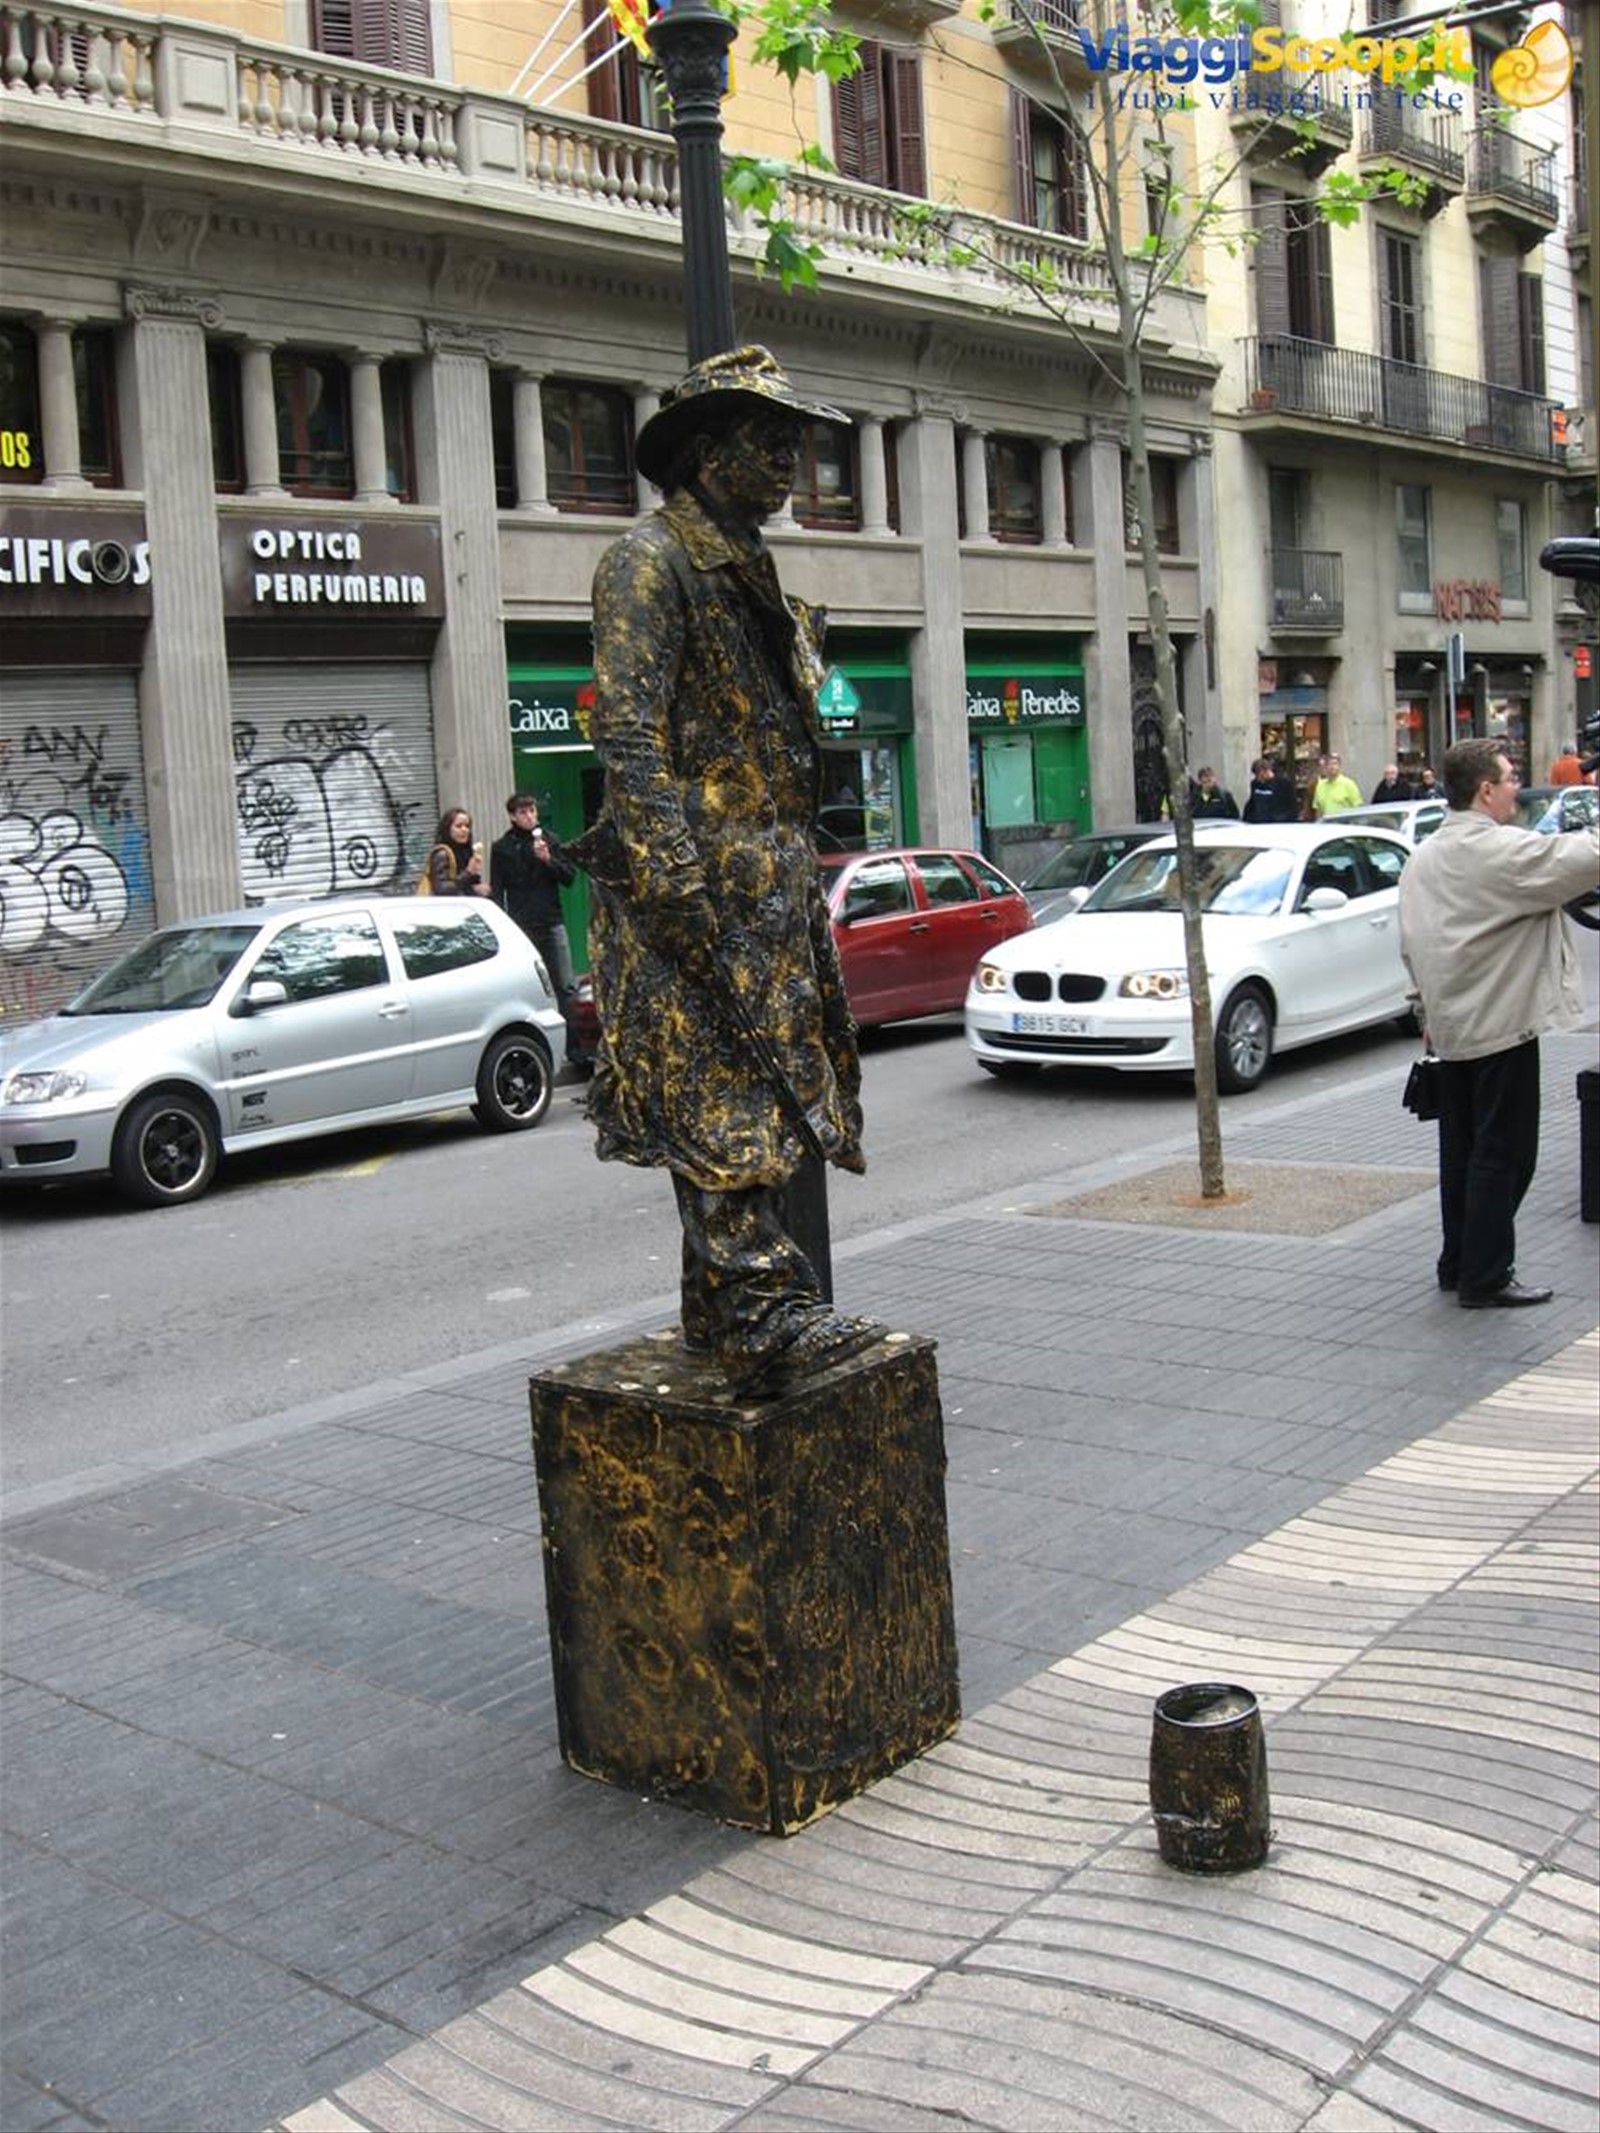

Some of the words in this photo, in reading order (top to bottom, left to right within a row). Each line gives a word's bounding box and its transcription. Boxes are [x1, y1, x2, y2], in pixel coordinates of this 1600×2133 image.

[253, 529, 362, 560] OPTICA
[254, 573, 427, 603] PERFUMERIA
[508, 698, 570, 732] Caixa
[966, 690, 1000, 717] aixa
